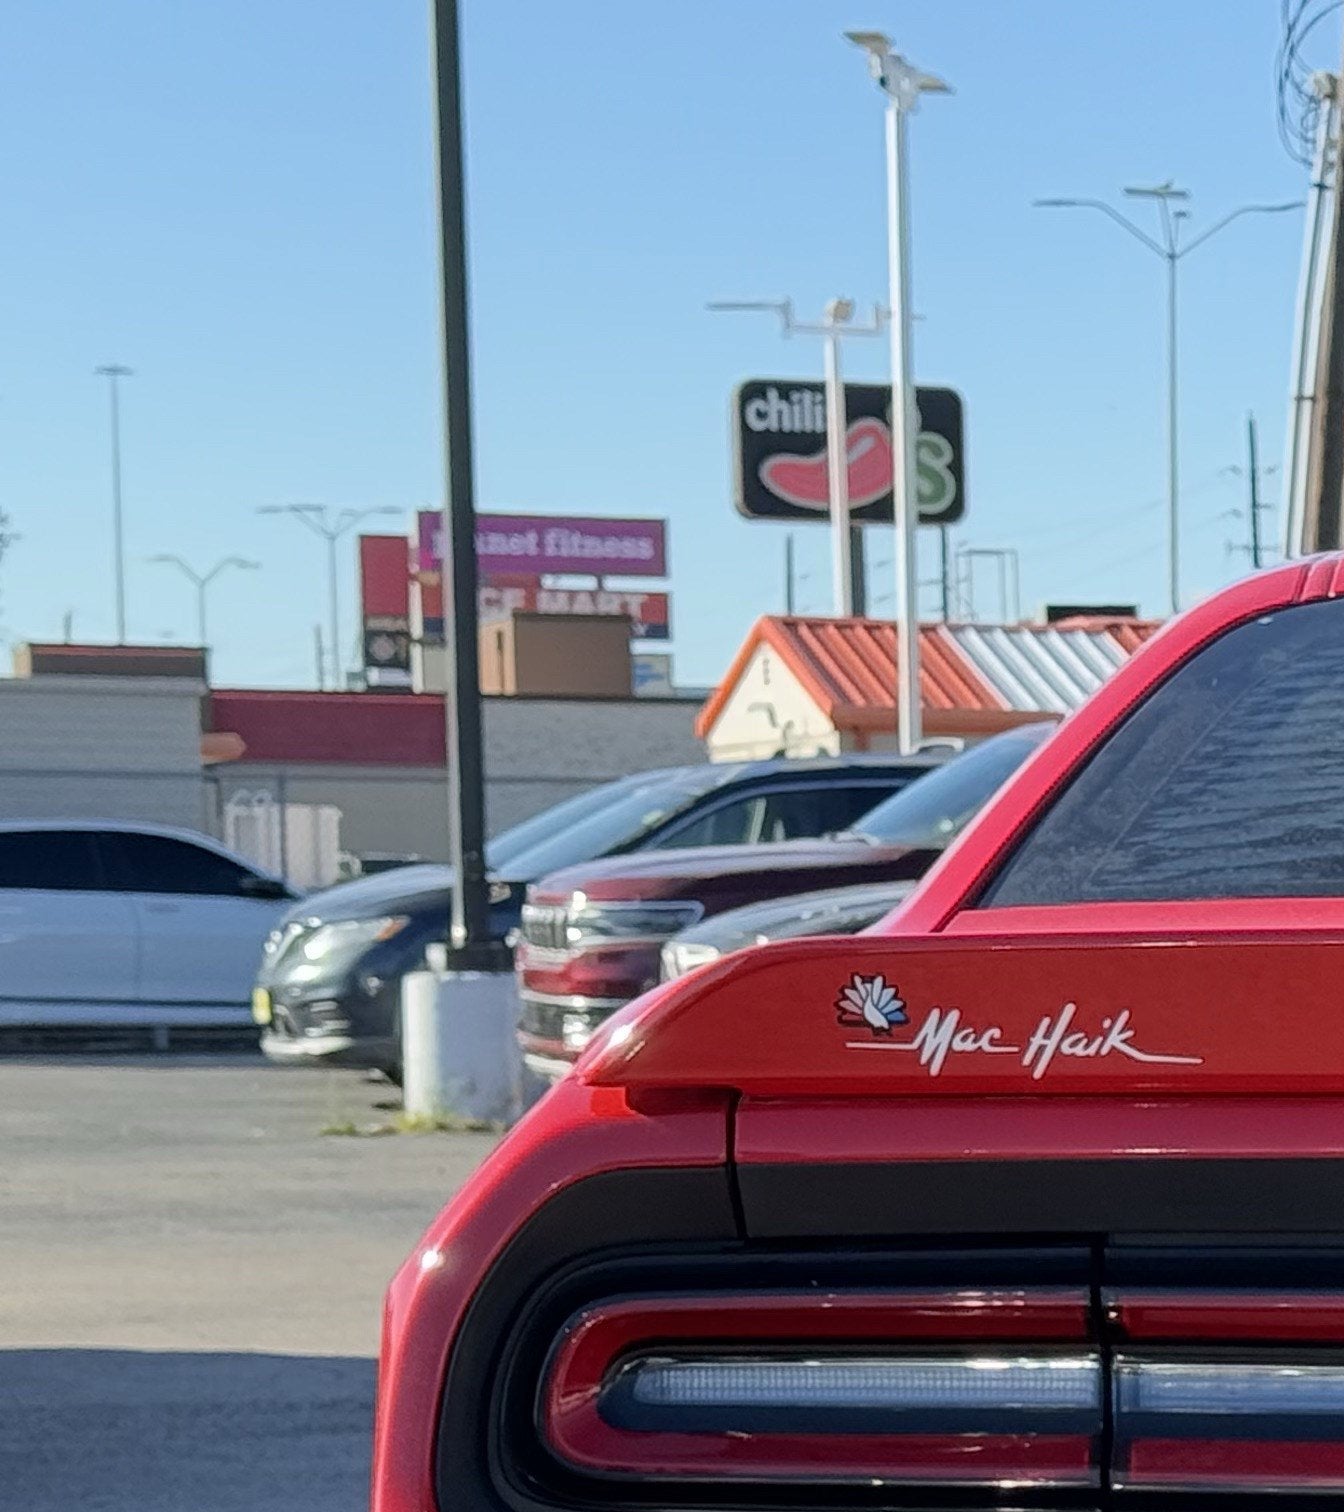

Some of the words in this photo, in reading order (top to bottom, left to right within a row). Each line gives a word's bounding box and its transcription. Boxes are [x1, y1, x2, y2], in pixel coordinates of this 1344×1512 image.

[542, 527, 655, 559] fitness
[845, 1007, 1019, 1077] Mac
[1021, 1002, 1204, 1081] Haik
